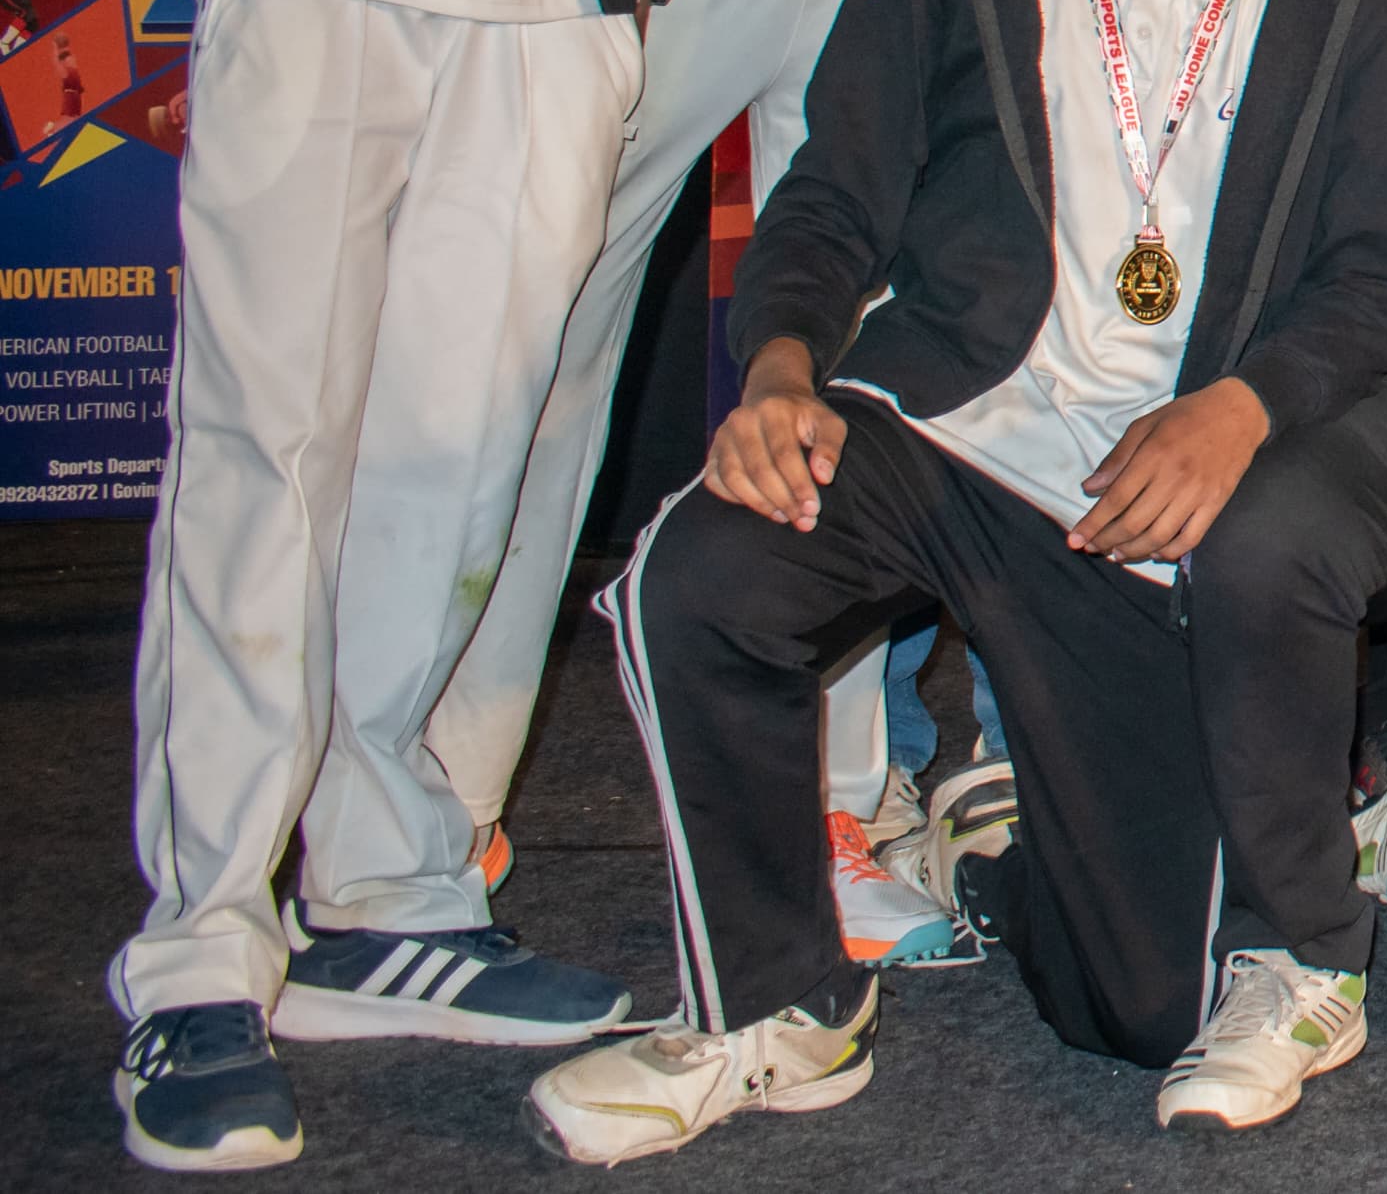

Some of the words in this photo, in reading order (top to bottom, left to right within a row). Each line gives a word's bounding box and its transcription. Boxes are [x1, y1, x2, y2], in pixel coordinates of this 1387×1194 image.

[1173, 88, 1190, 113] JU
[1182, 33, 1210, 86] HOME
[1112, 61, 1138, 132] LEAGUE
[0, 337, 70, 356] ERICAN
[77, 335, 168, 354] FOOTBALL
[5, 369, 123, 389] VOLLEYBALL
[66, 402, 136, 421] LIFTING
[48, 459, 103, 478] Sports
